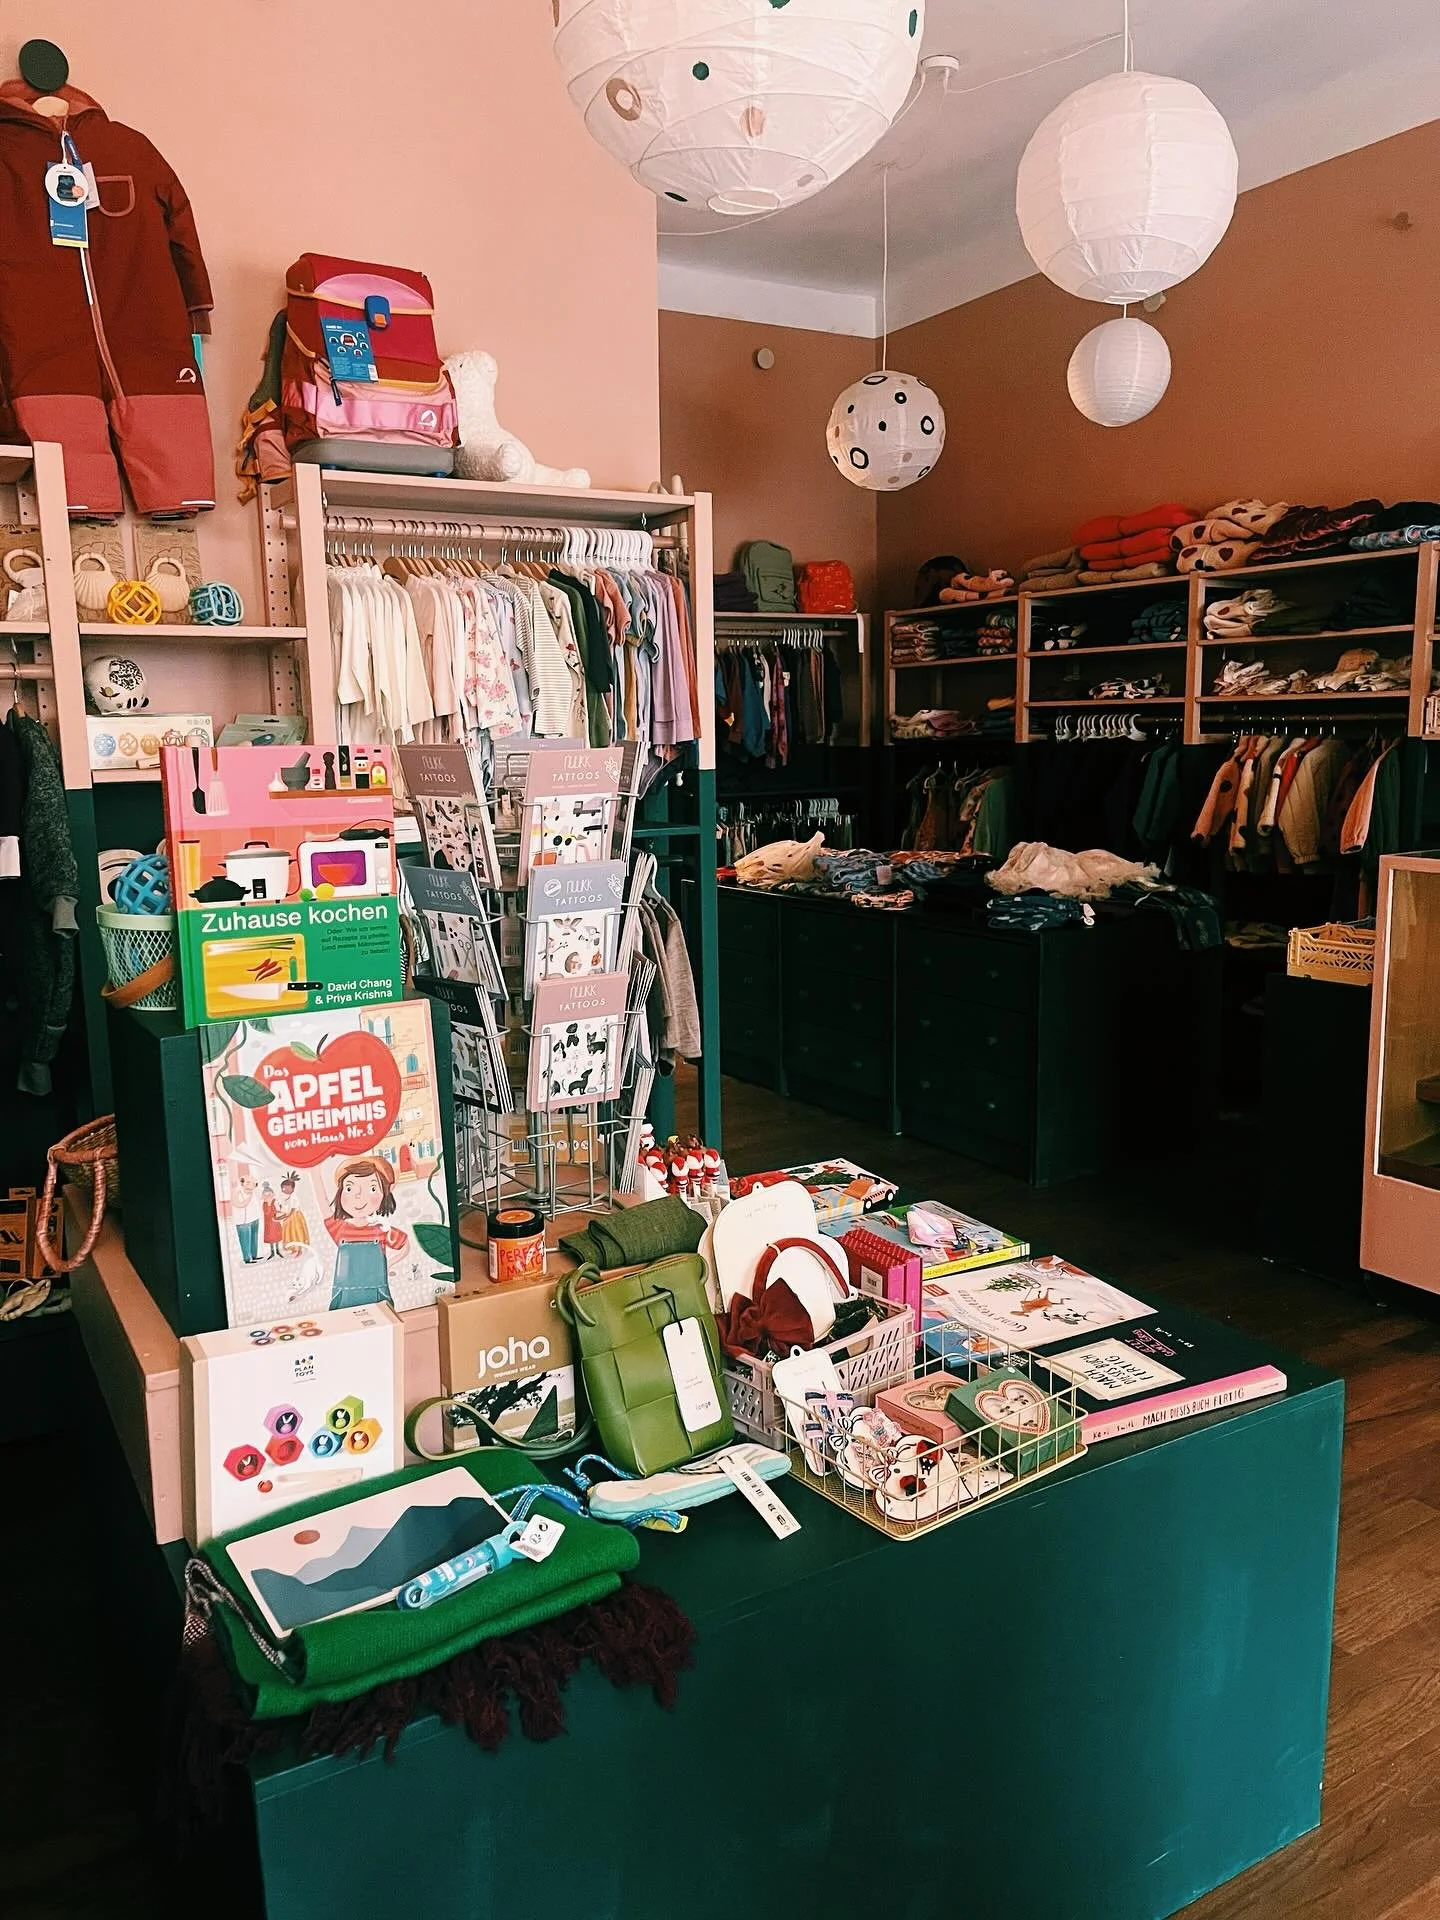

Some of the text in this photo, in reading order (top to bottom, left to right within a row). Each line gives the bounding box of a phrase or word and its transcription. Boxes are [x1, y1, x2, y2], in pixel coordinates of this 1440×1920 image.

[420, 773, 456, 782] TATTOOS
[552, 772, 600, 782] TATTOOS
[425, 890, 462, 900] TATTOOS
[555, 894, 602, 906] TATTOOS
[201, 903, 388, 933] Zuhause kochen
[327, 979, 392, 992] David Chang
[315, 990, 393, 1005] & Priya Krishna
[559, 998, 606, 1012] TATTOOS
[263, 1064, 289, 1079] Das
[267, 1065, 383, 1115] APFEL
[267, 1100, 387, 1136] GEHEIMNIS
[284, 1138, 309, 1150] von
[311, 1131, 344, 1145] Haus
[478, 1335, 550, 1379] joha
[294, 1365, 314, 1373] PLAN
[1104, 1355, 1154, 1380] FERTIG
[1084, 1368, 1122, 1389] MACH
[1142, 1409, 1166, 1426] MACH
[1192, 1398, 1210, 1413] BUCH
[1213, 1387, 1245, 1407] FERTIG
